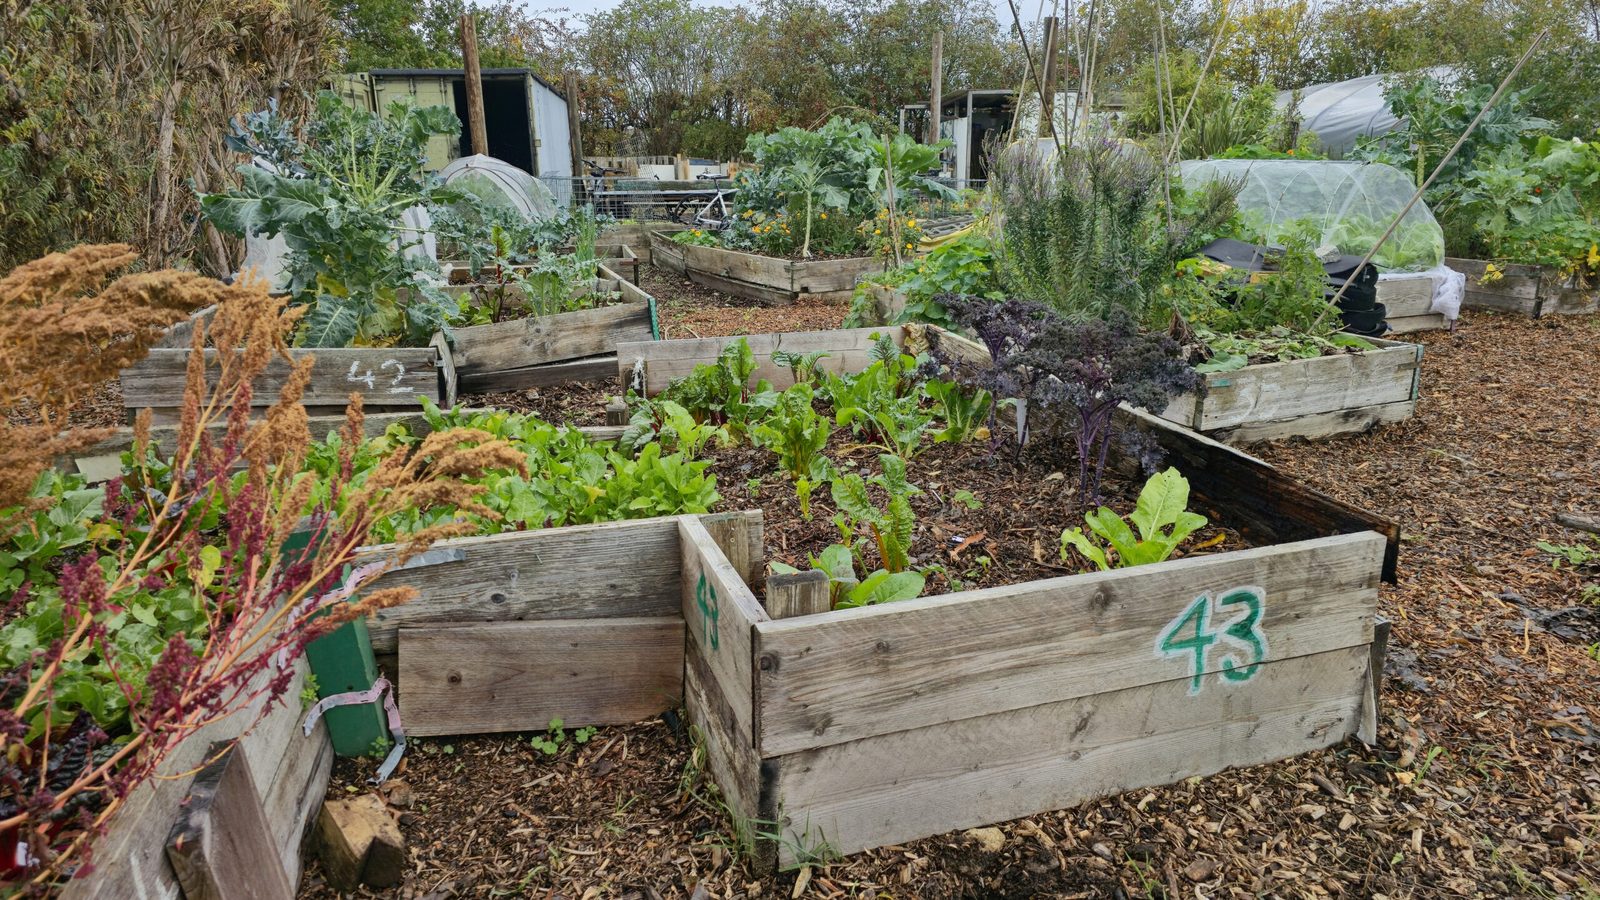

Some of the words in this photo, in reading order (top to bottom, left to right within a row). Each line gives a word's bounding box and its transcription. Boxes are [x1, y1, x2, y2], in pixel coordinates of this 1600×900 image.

[346, 359, 415, 394] 42
[697, 572, 719, 651] 43
[1155, 587, 1267, 695] 43
